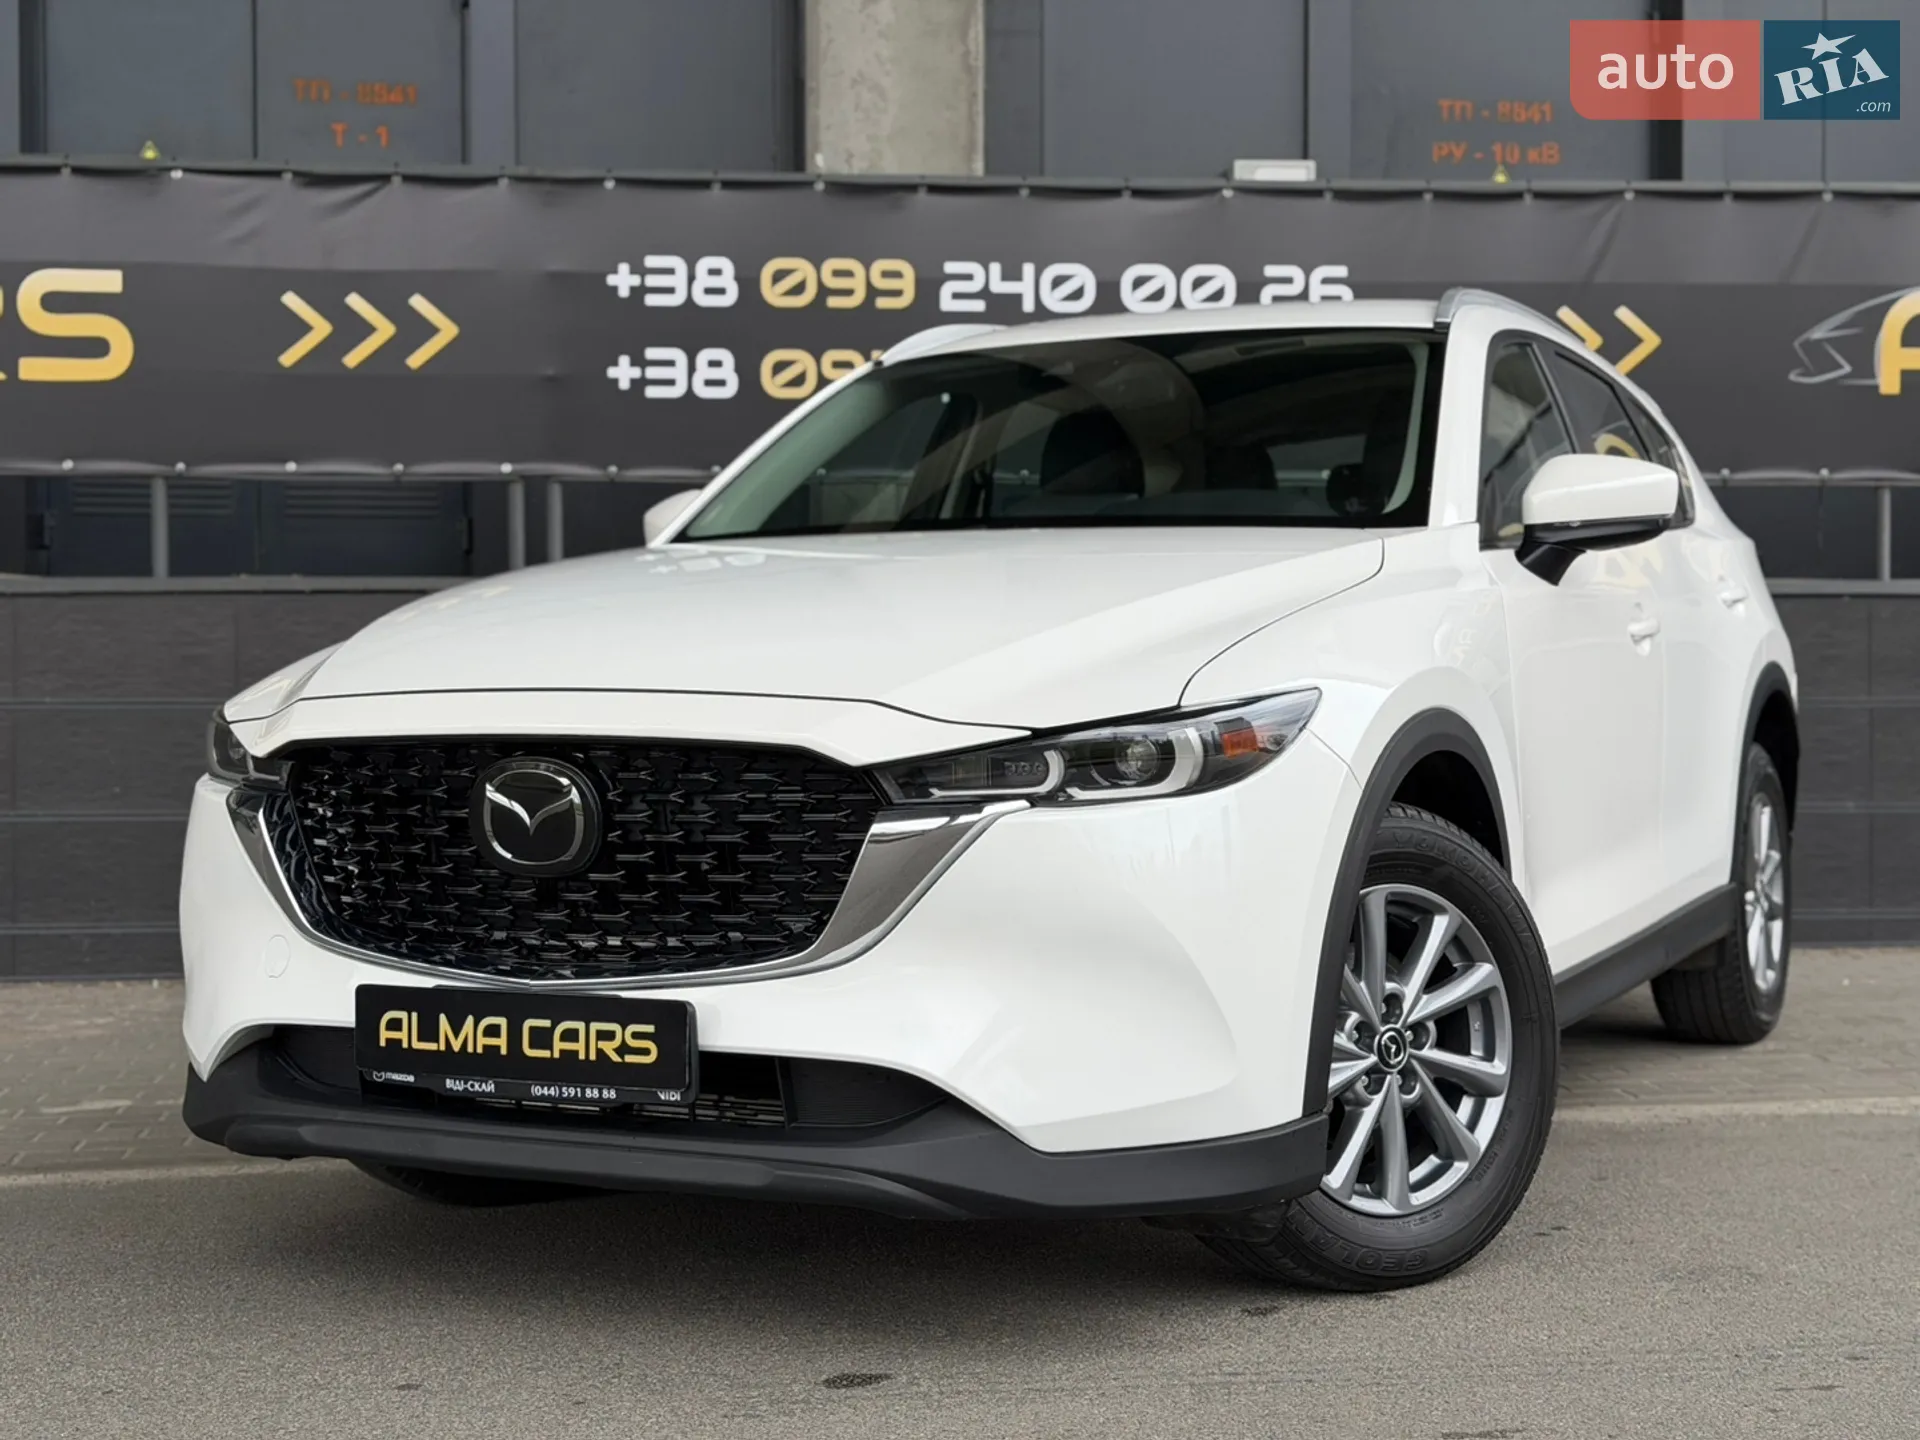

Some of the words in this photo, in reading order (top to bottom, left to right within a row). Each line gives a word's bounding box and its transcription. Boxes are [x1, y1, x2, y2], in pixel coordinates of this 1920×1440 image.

[1492, 141, 1520, 166] 10
[606, 255, 739, 308] +38
[760, 257, 915, 309] 099
[939, 261, 1097, 313] 240
[1120, 263, 1237, 314] 00
[606, 347, 739, 399] +38
[379, 1010, 508, 1055] ALMA
[522, 1018, 659, 1064] CARS
[530, 1085, 560, 1097] (044)
[561, 1086, 582, 1098] 591
[585, 1087, 600, 1099] 88
[602, 1088, 617, 1100] 88
